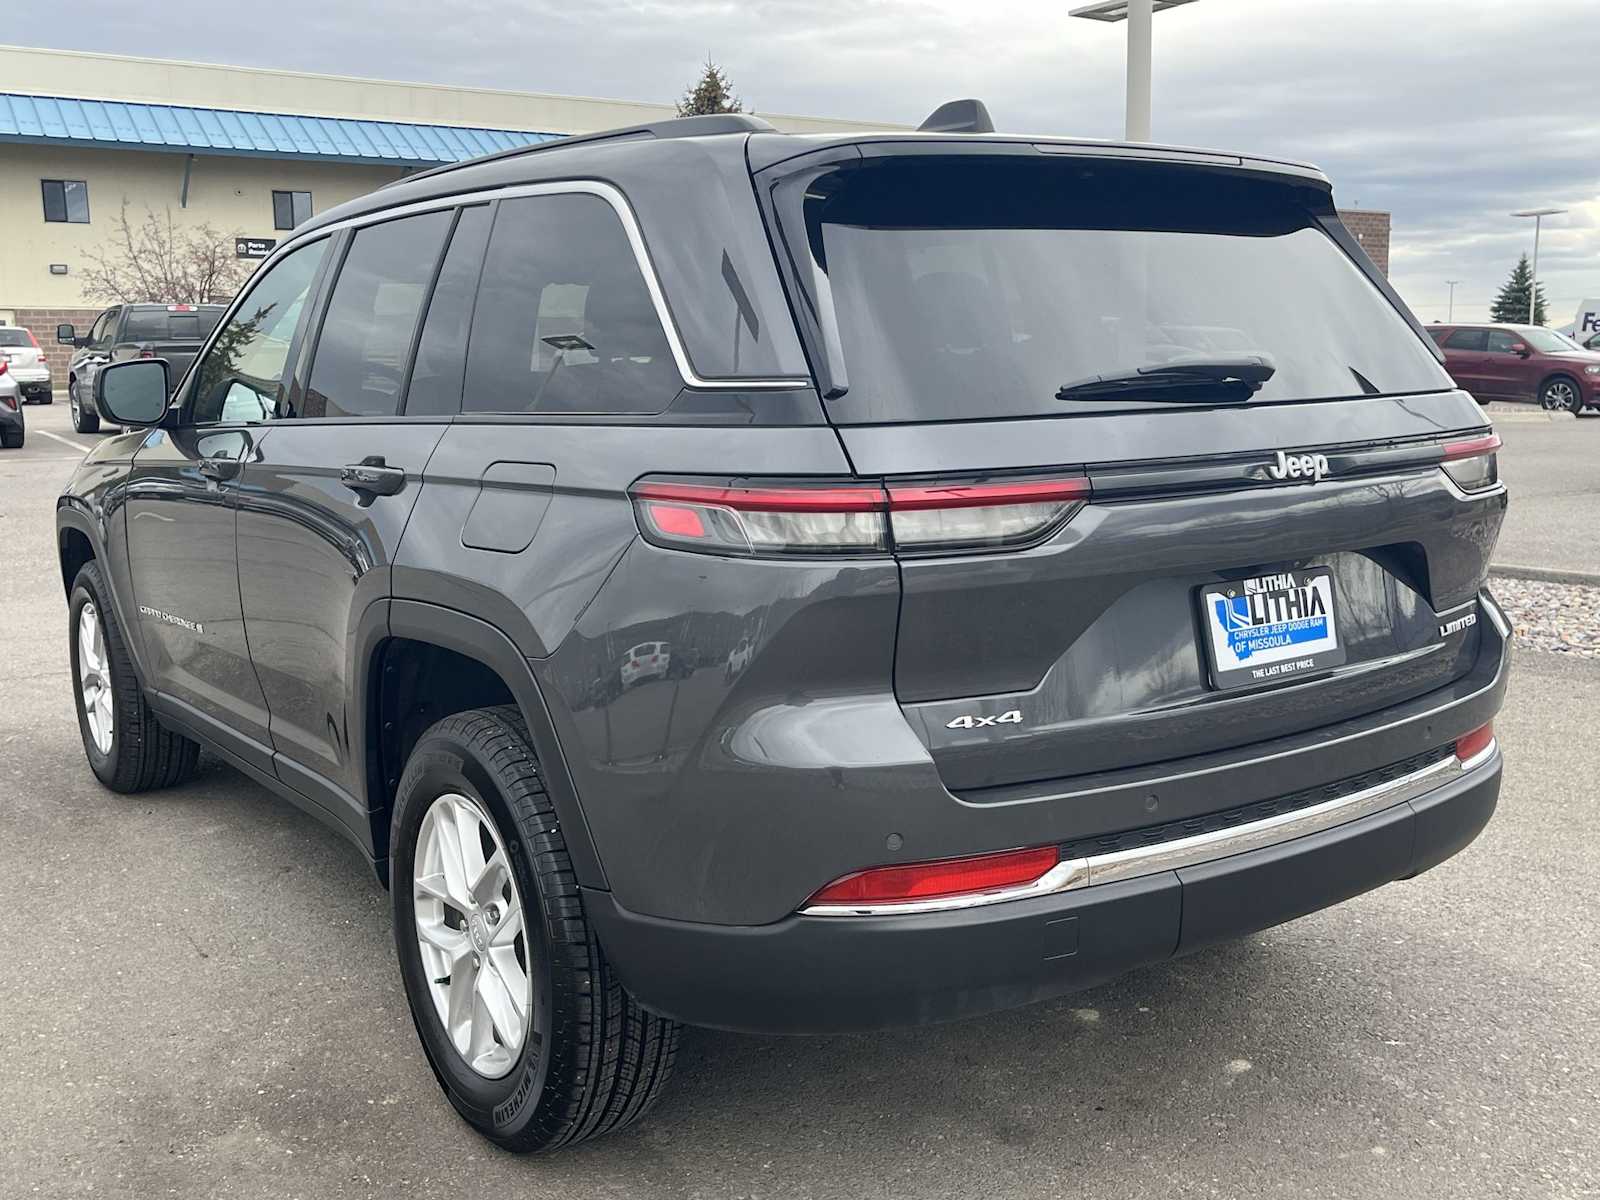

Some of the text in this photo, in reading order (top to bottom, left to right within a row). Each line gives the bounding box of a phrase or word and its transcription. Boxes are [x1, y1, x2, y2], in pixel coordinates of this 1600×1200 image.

[1269, 451, 1329, 481] Jeep
[1256, 573, 1296, 593] LITHIA
[1249, 586, 1326, 625] LITHIA
[1234, 618, 1324, 640] CHRYSLER JEEP DODGE RAM
[1440, 613, 1477, 637] LIMITED
[1235, 634, 1292, 653] OF MISSOULA
[1252, 658, 1315, 679] THE LAST BEST PRICE
[946, 710, 1023, 728] 4x4
[495, 1070, 532, 1123] MICHELIN
